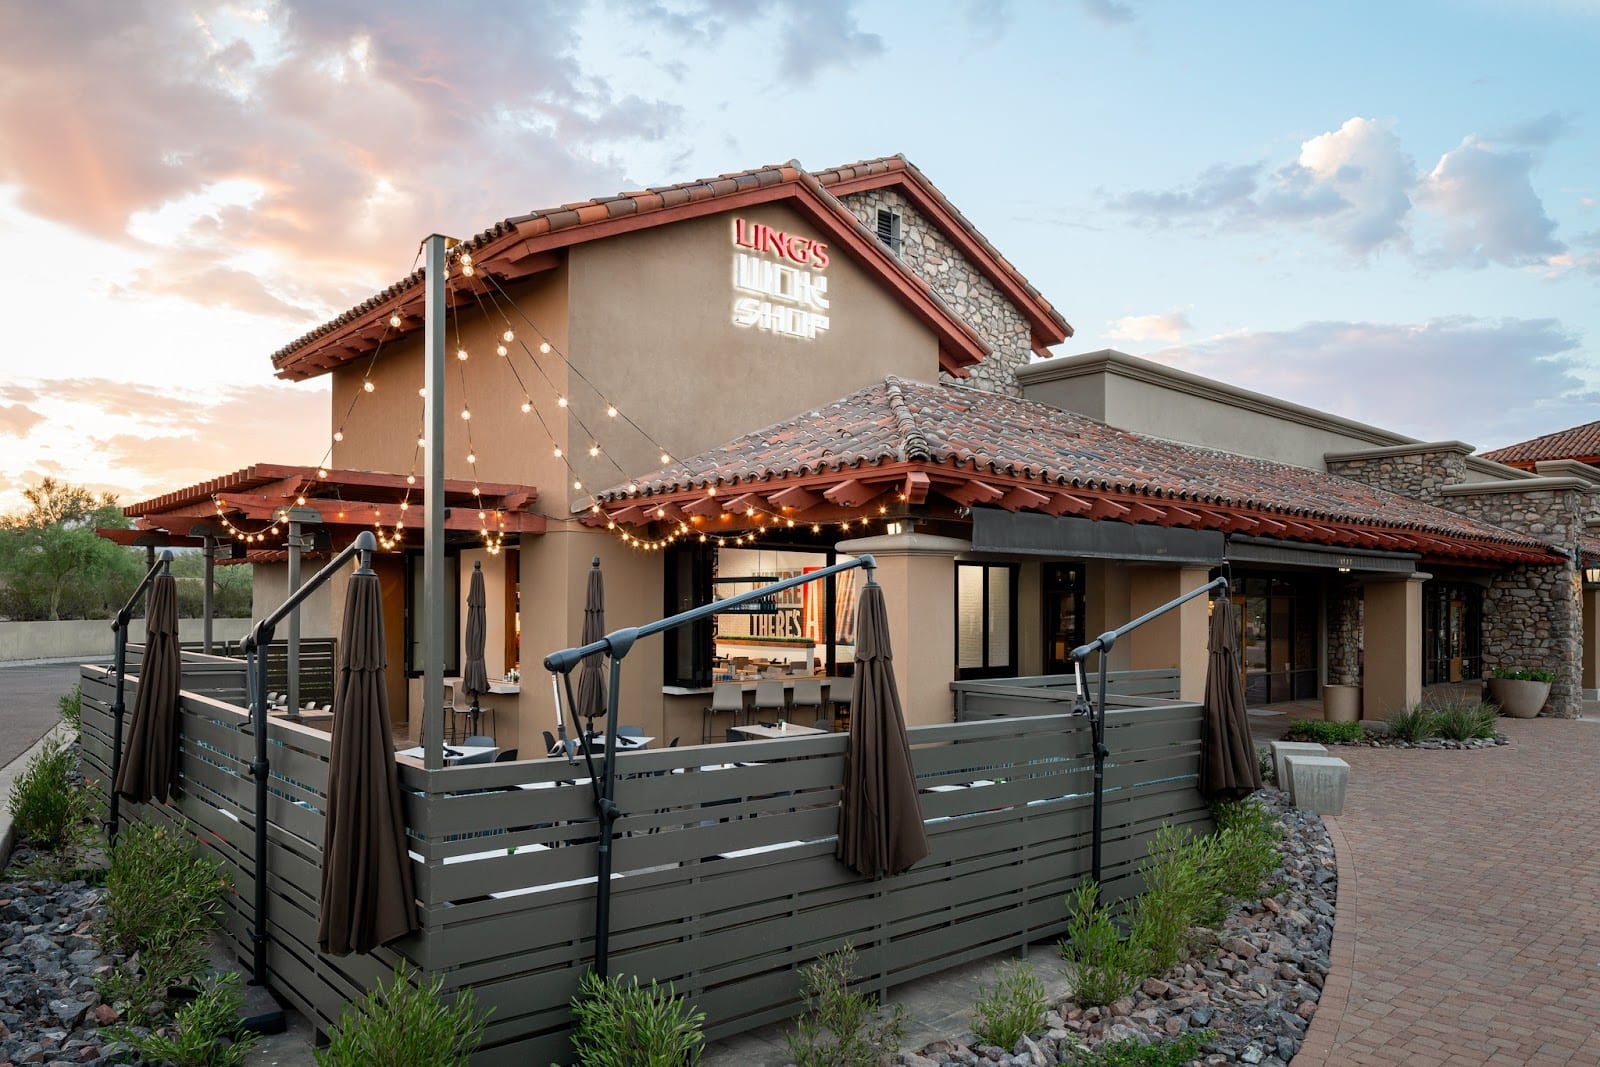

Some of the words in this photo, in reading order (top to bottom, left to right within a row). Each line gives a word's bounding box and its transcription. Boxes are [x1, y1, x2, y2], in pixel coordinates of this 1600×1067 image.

[736, 218, 830, 268] LING'S
[736, 253, 830, 309] WOK
[735, 298, 830, 339] SHOP
[752, 608, 802, 639] THERE'S
